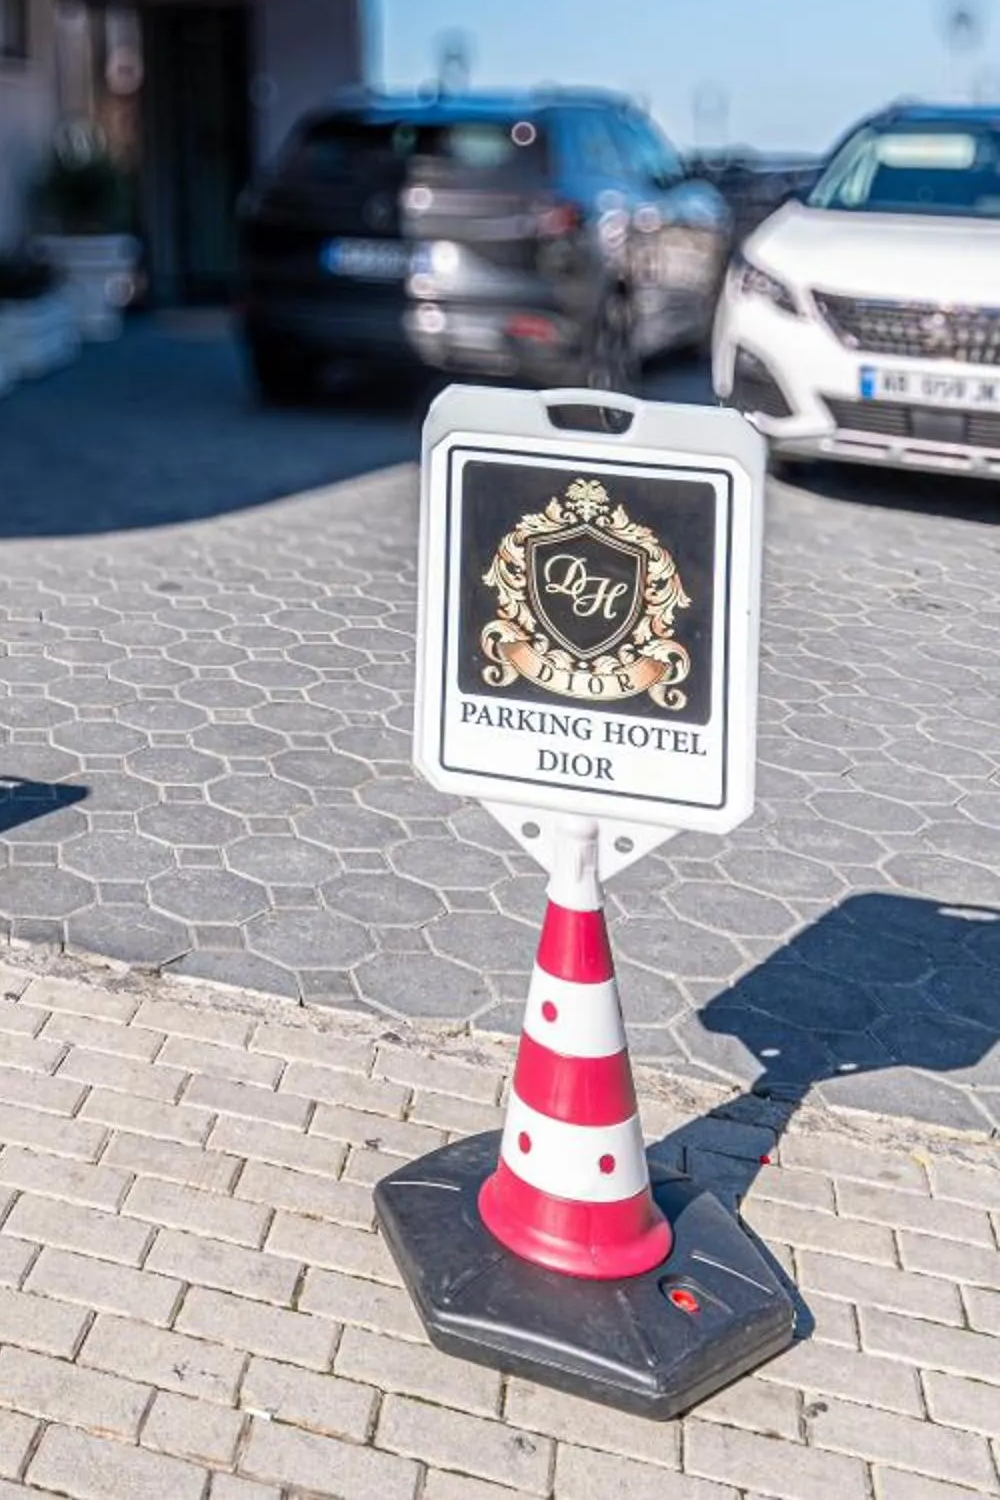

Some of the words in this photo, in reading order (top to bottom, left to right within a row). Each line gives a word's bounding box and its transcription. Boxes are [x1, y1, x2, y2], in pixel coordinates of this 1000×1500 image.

[544, 554, 628, 619] DH
[536, 663, 634, 695] DIOR
[460, 701, 592, 741] PARKING
[603, 721, 707, 756] HOTEL
[537, 749, 614, 780] DIOR
